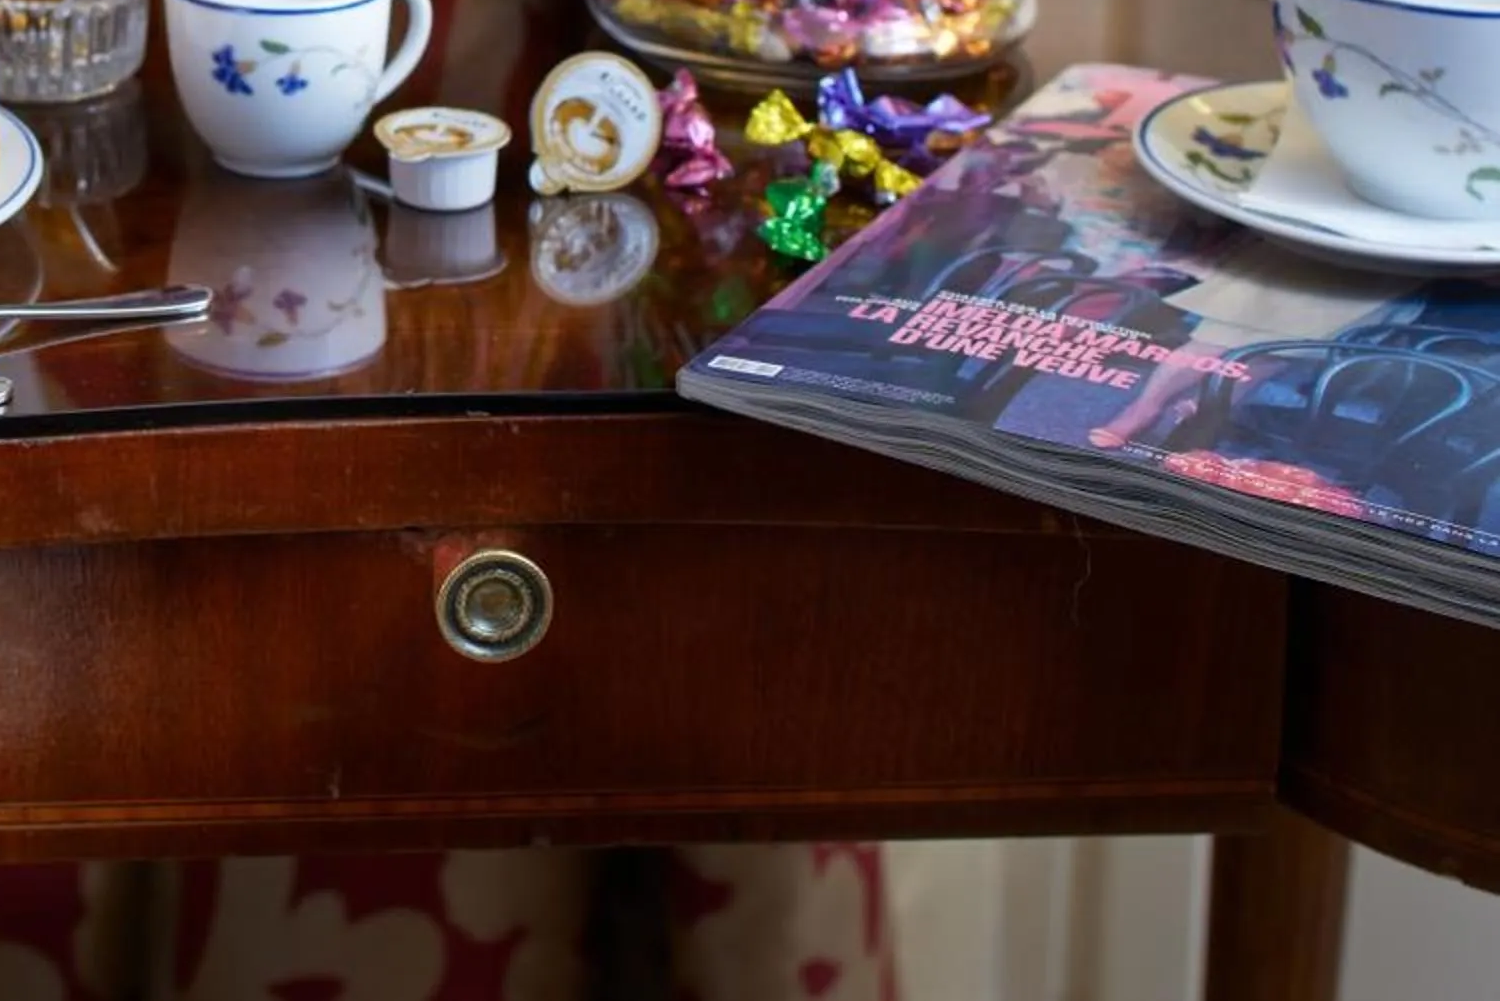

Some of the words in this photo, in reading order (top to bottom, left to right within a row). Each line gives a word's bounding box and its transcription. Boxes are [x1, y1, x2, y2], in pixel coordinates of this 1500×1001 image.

[848, 303, 899, 324] LA
[905, 313, 1105, 365] REVANCHE
[921, 299, 1064, 339] IMELDA
[888, 327, 1007, 361] D'UNE
[1012, 349, 1141, 390] VEUVE
